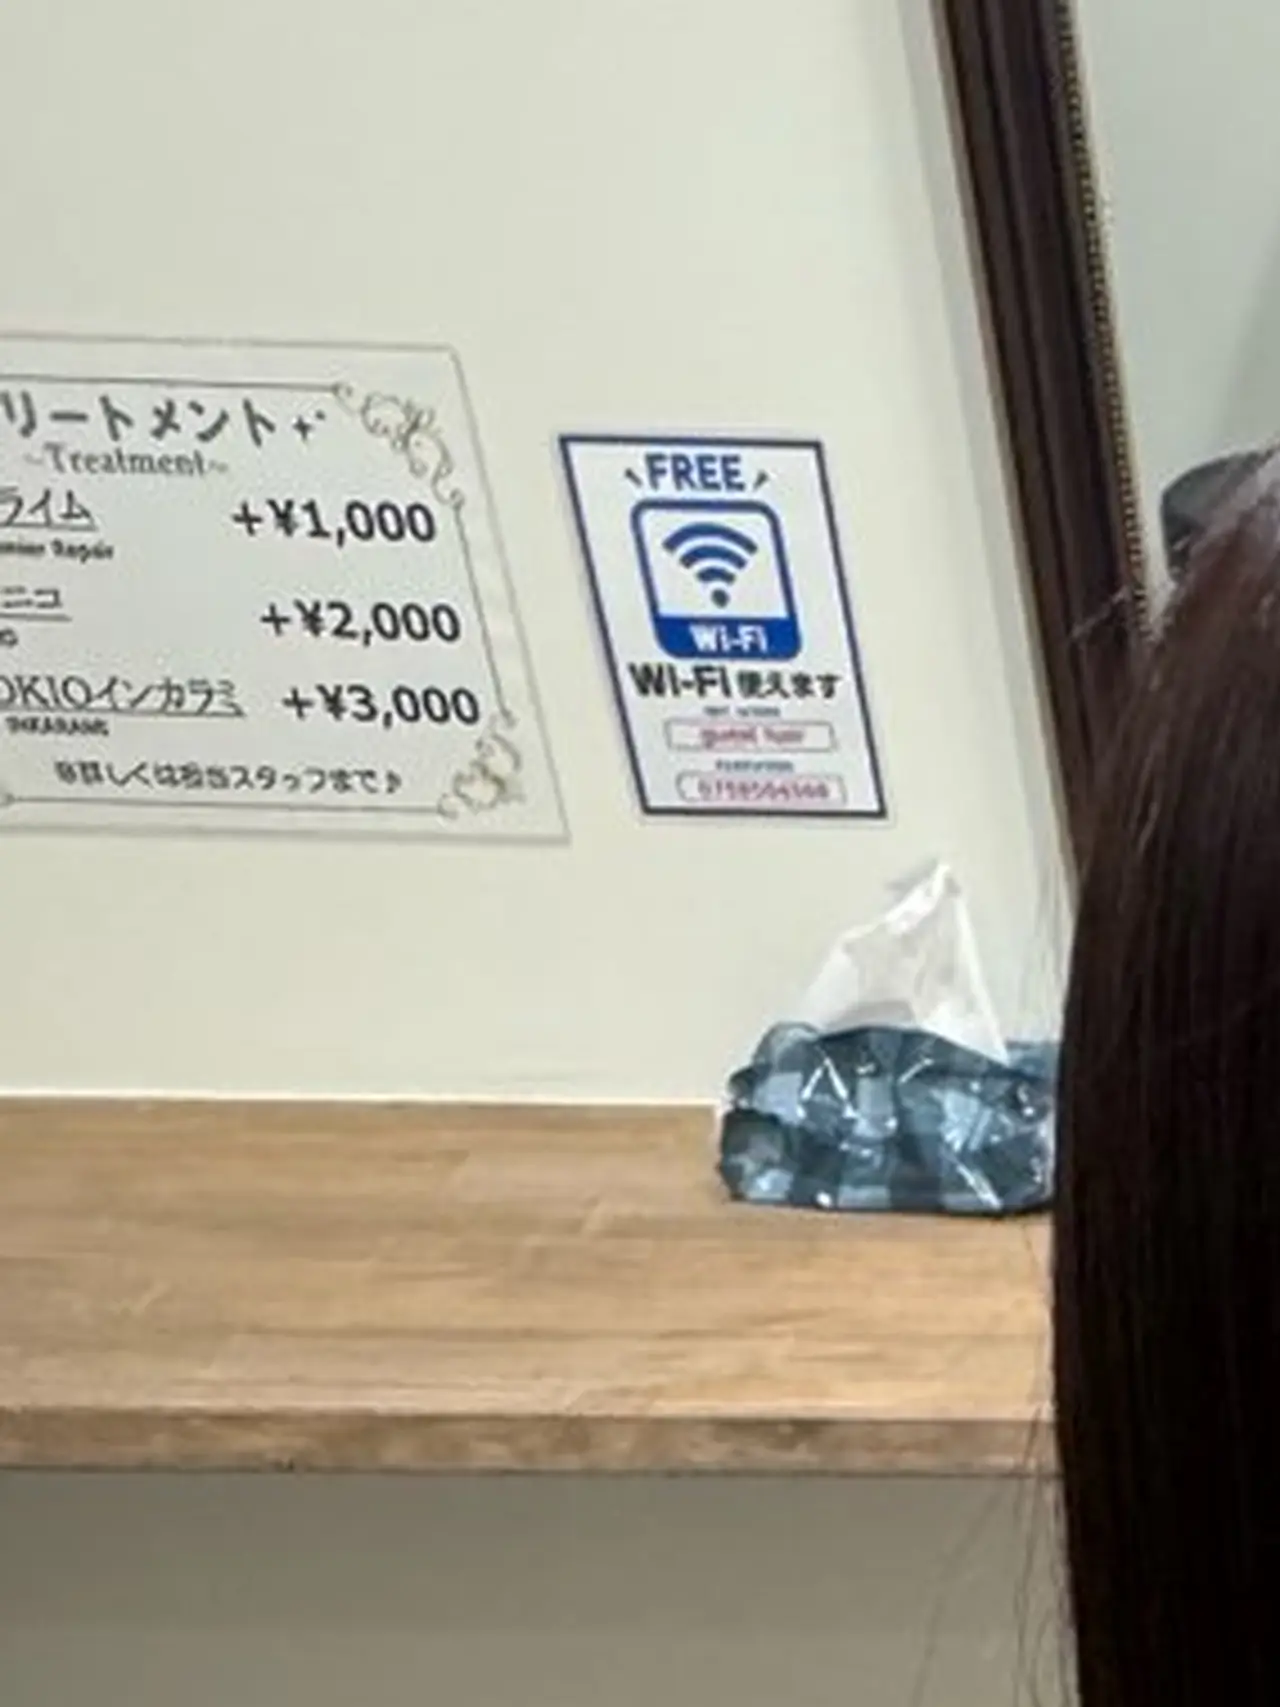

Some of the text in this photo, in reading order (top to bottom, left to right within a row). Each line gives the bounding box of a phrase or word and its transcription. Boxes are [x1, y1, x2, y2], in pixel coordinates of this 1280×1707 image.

[645, 452, 746, 492] FREE
[231, 497, 437, 547] +¥1,000
[259, 599, 462, 647] +¥2,000
[282, 681, 481, 730] +¥3,000
